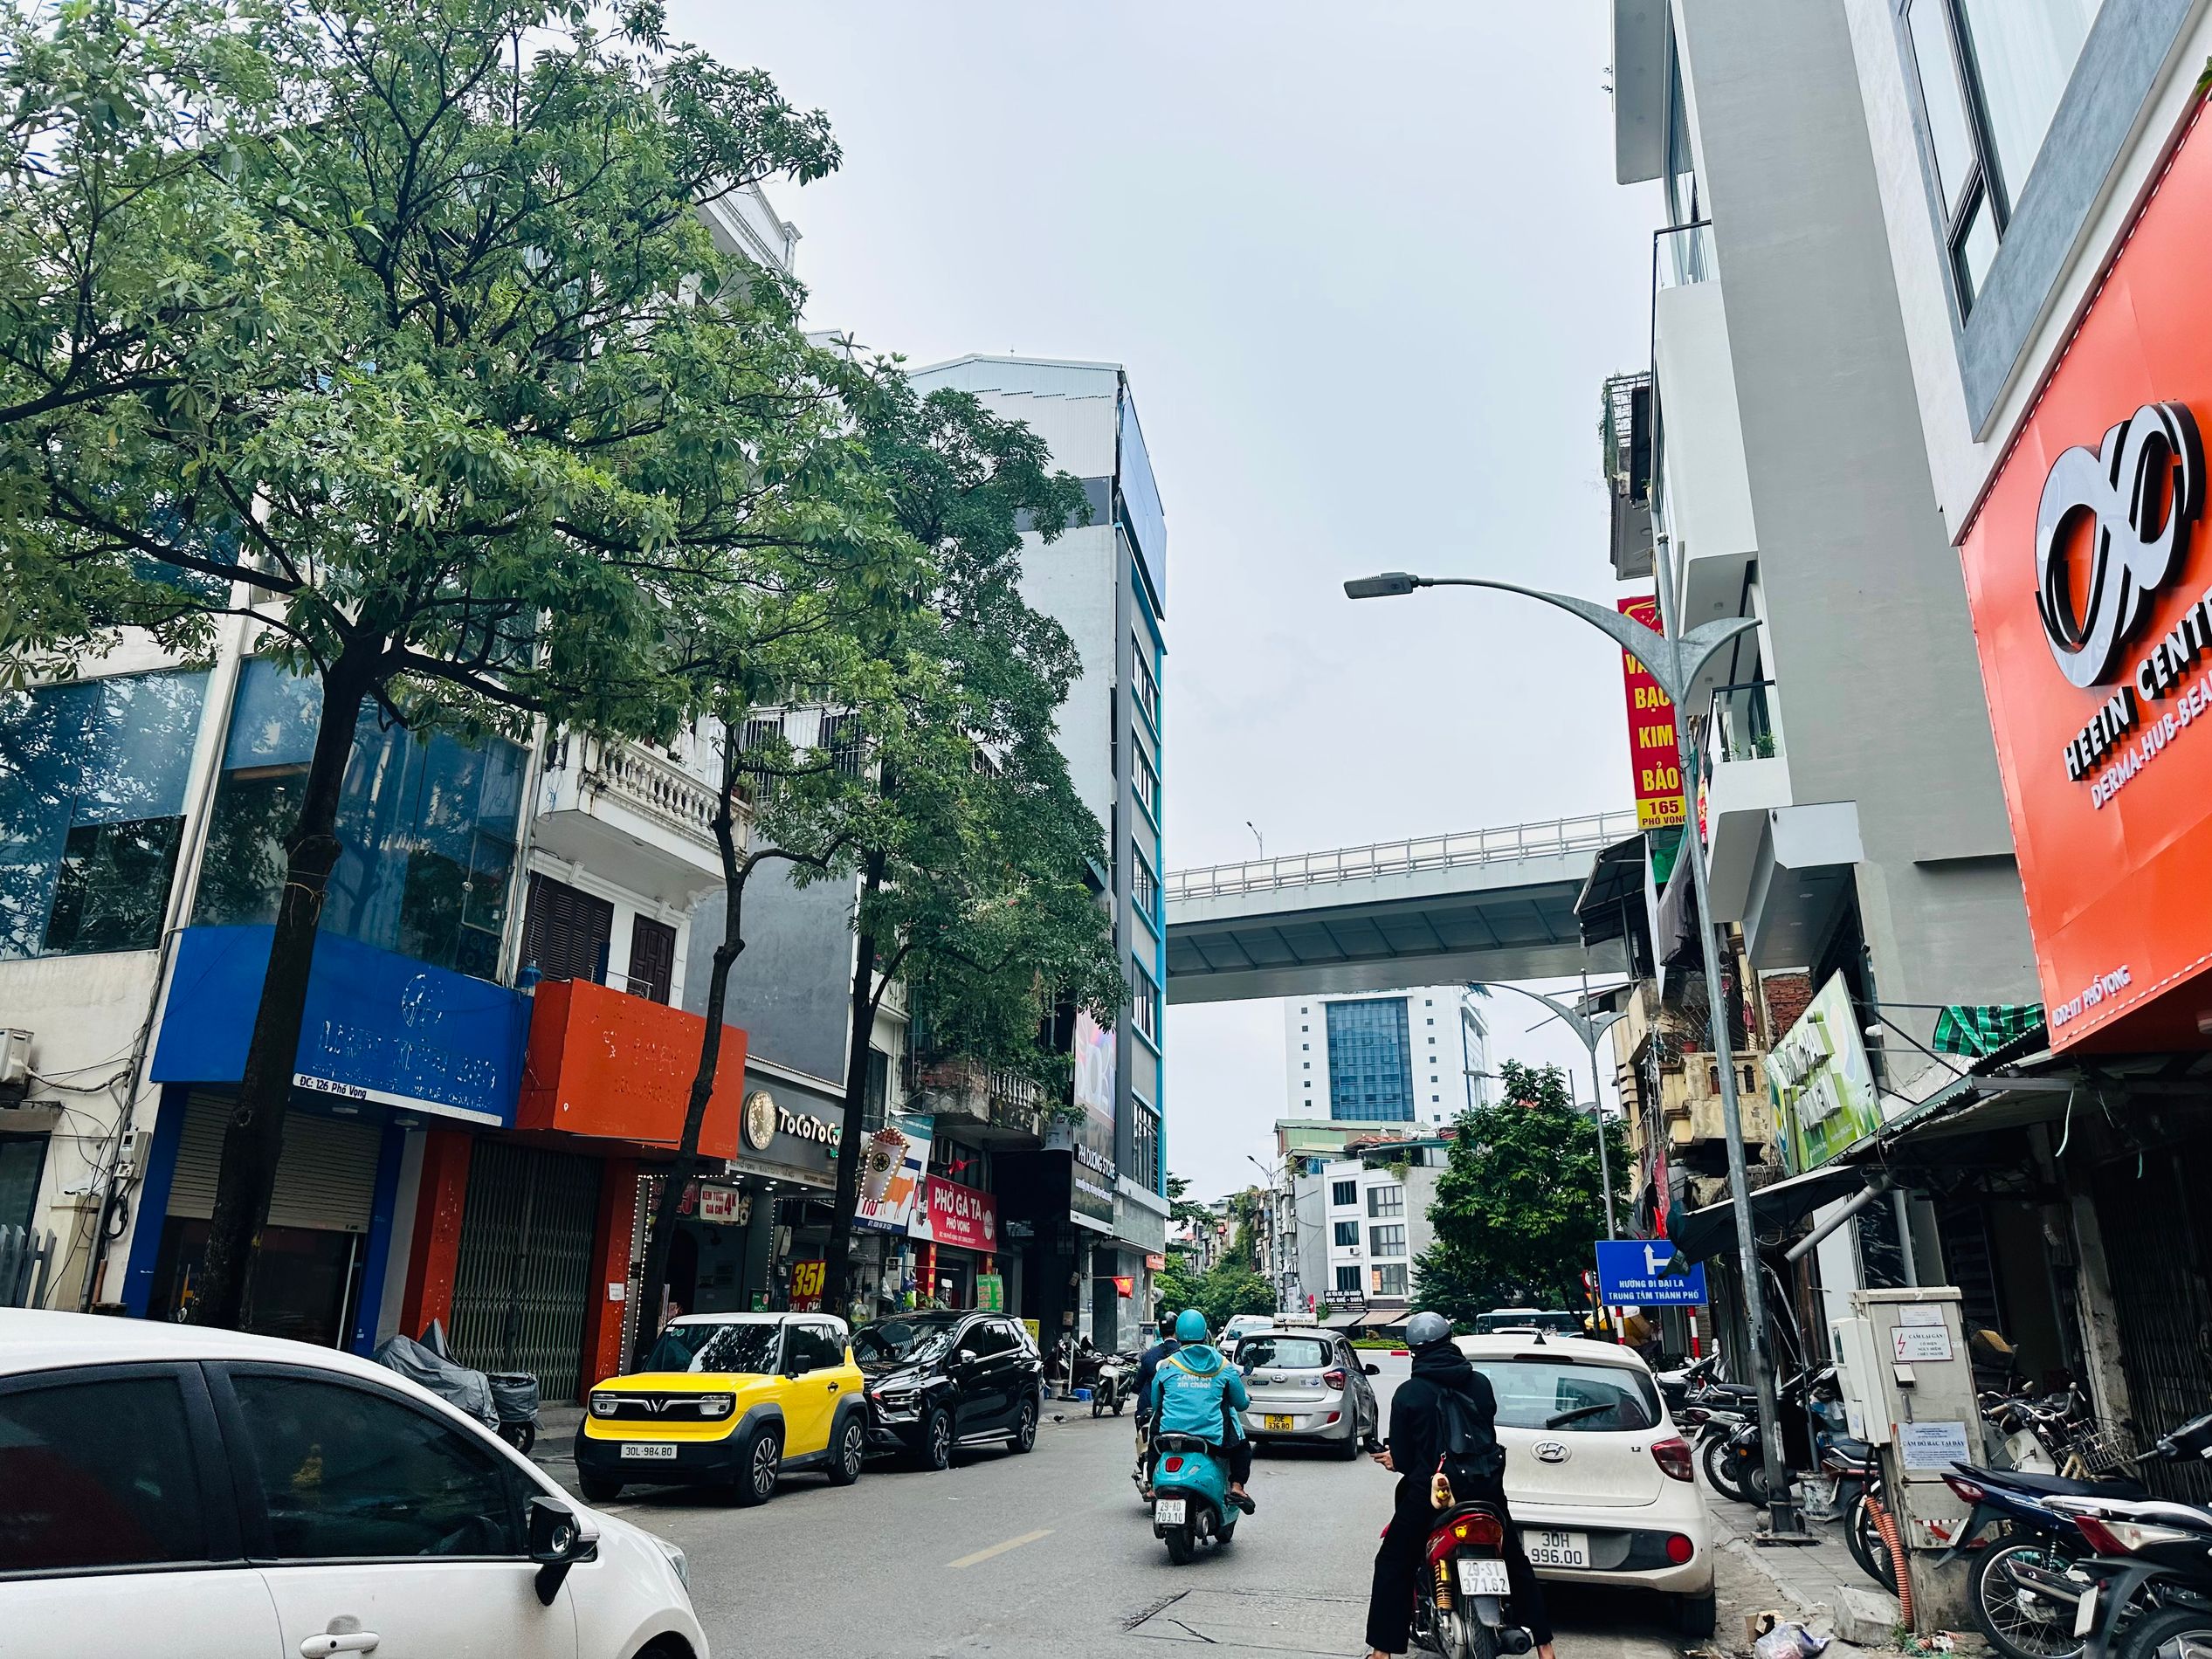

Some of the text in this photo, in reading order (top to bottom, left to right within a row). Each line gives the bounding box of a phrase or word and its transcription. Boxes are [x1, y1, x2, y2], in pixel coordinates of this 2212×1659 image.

[1638, 725, 1674, 748] KIM
[2062, 685, 2131, 782] HEEIN
[2091, 670, 2212, 810] DERMA-HUB-BEA
[1642, 761, 1678, 792] BẢO
[1649, 801, 1678, 815] 165
[1642, 815, 1661, 825] PHỐ
[2082, 974, 2103, 1008] PHỐ
[2100, 965, 2131, 997] VỌNG
[300, 1077, 367, 1099] ĐC: 126 Phố Vọng
[1102, 1157, 1116, 1180] STORE
[934, 1184, 982, 1221] PHỞ GÀ TA
[946, 1215, 956, 1229] PHỐ
[957, 1219, 970, 1234] VỌNG
[1619, 1277, 1646, 1288] HƯỚNG
[1658, 1280, 1672, 1290] ĐẠI
[1673, 1279, 1684, 1288] LA
[1635, 1291, 1653, 1300] TÂM
[1655, 1290, 1681, 1299] THÀNH
[1683, 1288, 1699, 1299] PHỐ
[1157, 1511, 1183, 1522] 703.10
[1541, 1532, 1569, 1547] 30H
[1531, 1548, 1581, 1565] 996.00
[1463, 1577, 1507, 1593] 371.62
